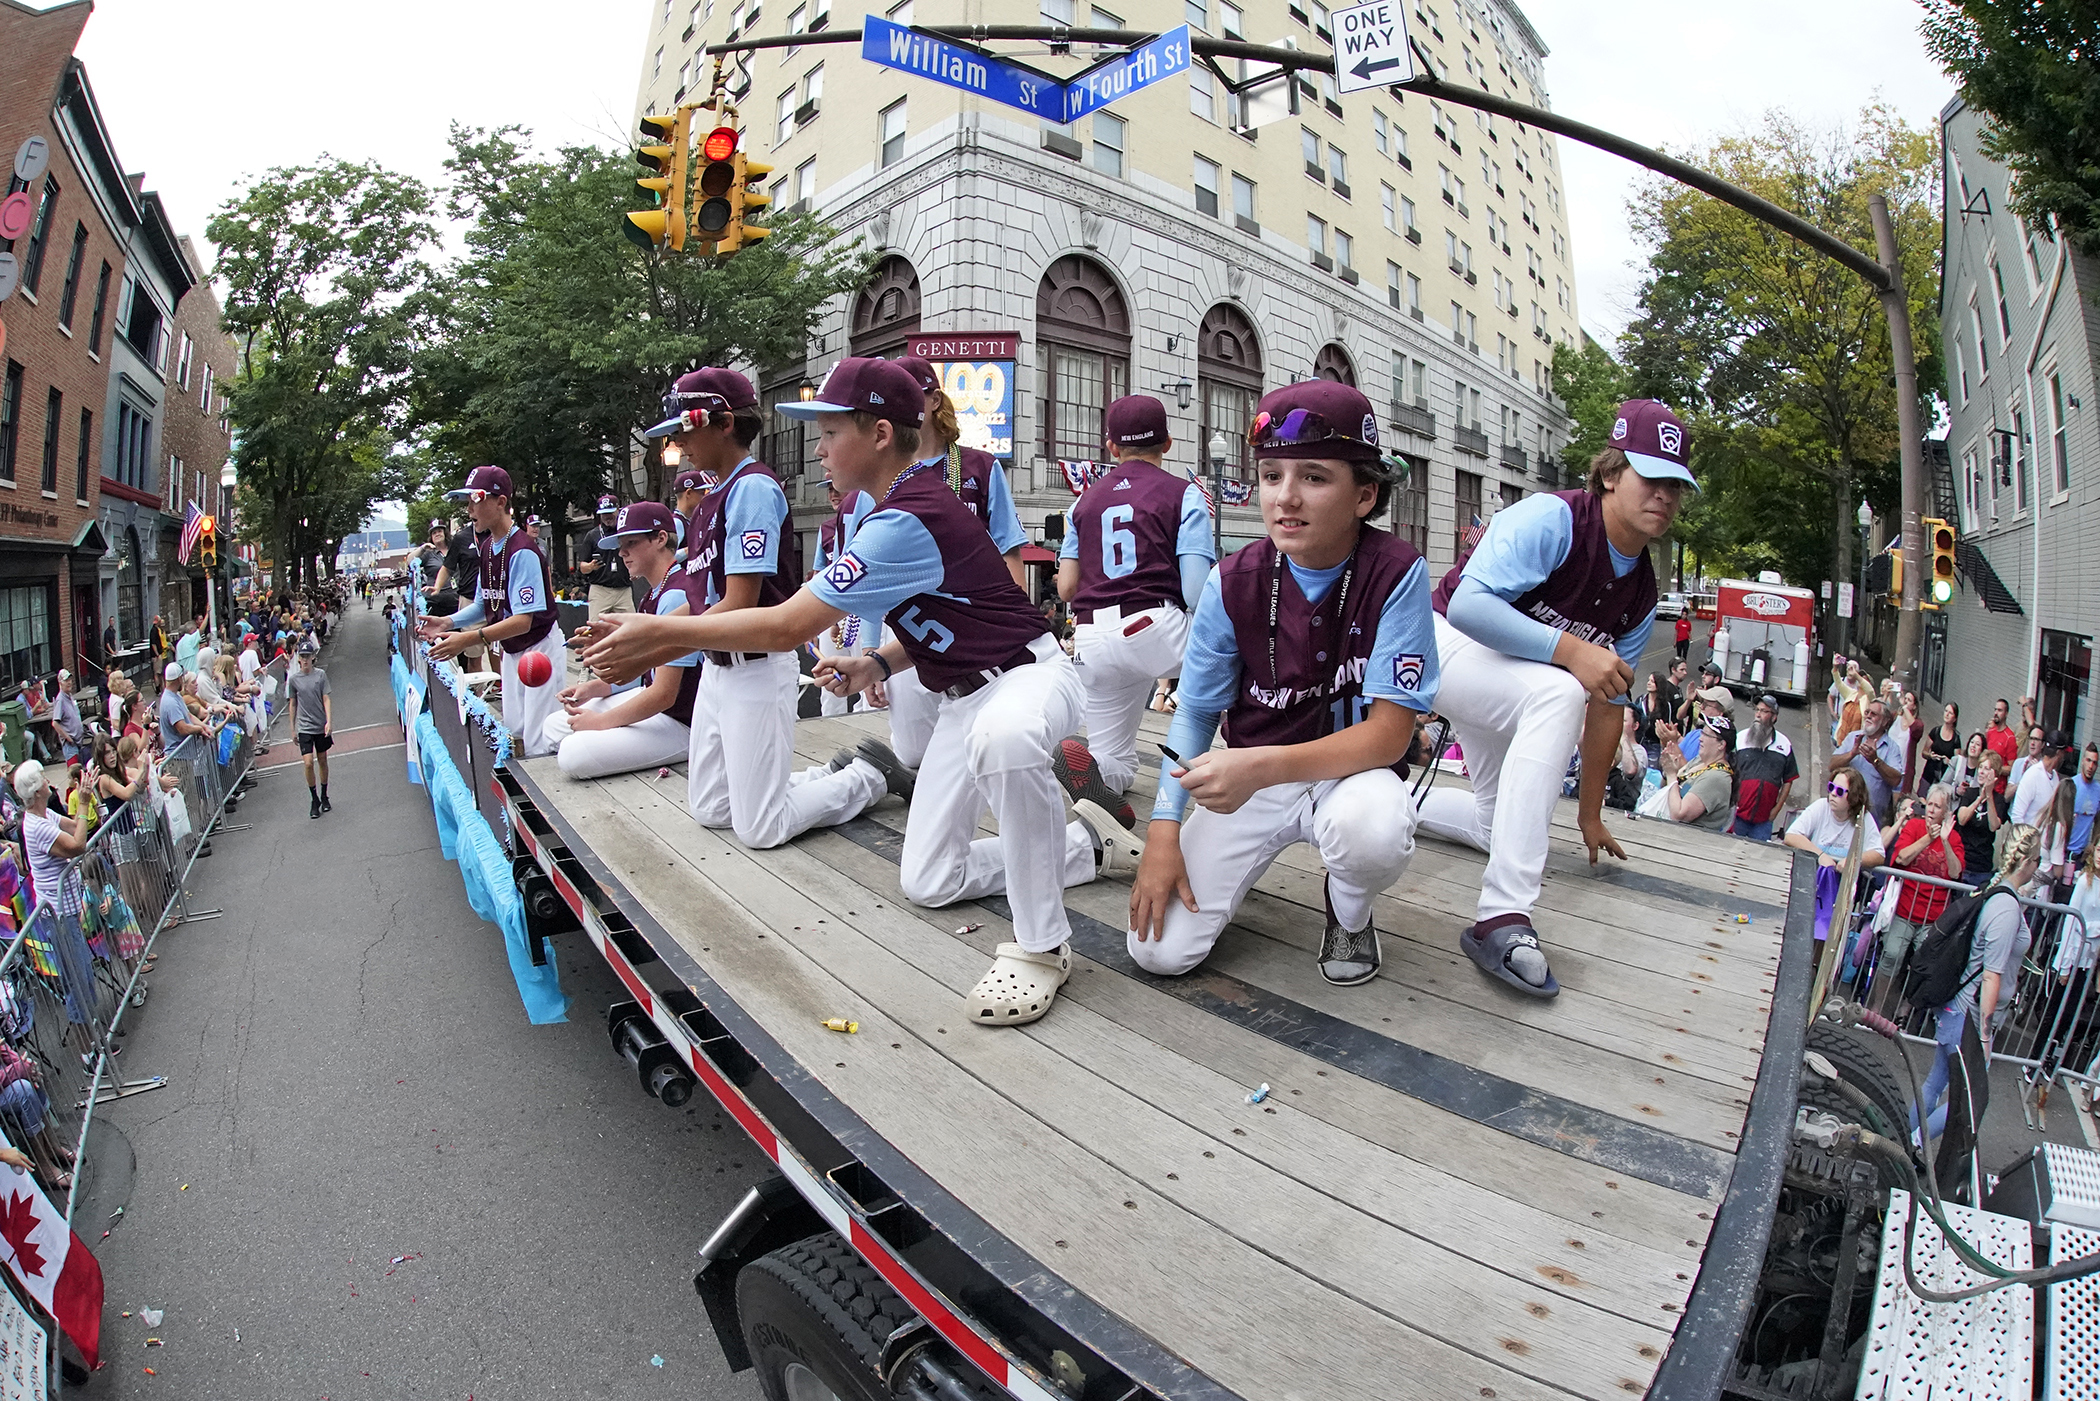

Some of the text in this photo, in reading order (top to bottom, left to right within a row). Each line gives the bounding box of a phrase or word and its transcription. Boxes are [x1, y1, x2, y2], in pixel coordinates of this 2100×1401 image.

[1344, 5, 1392, 33] ONE
[1344, 26, 1394, 55] WAY
[889, 28, 1038, 109] William St
[1070, 41, 1183, 115] W Fourth St
[915, 341, 1006, 356] GENETTI
[1101, 503, 1138, 580] 6
[897, 603, 956, 654] 5
[1528, 600, 1571, 632] NEW
[1249, 679, 1293, 710] NEW
